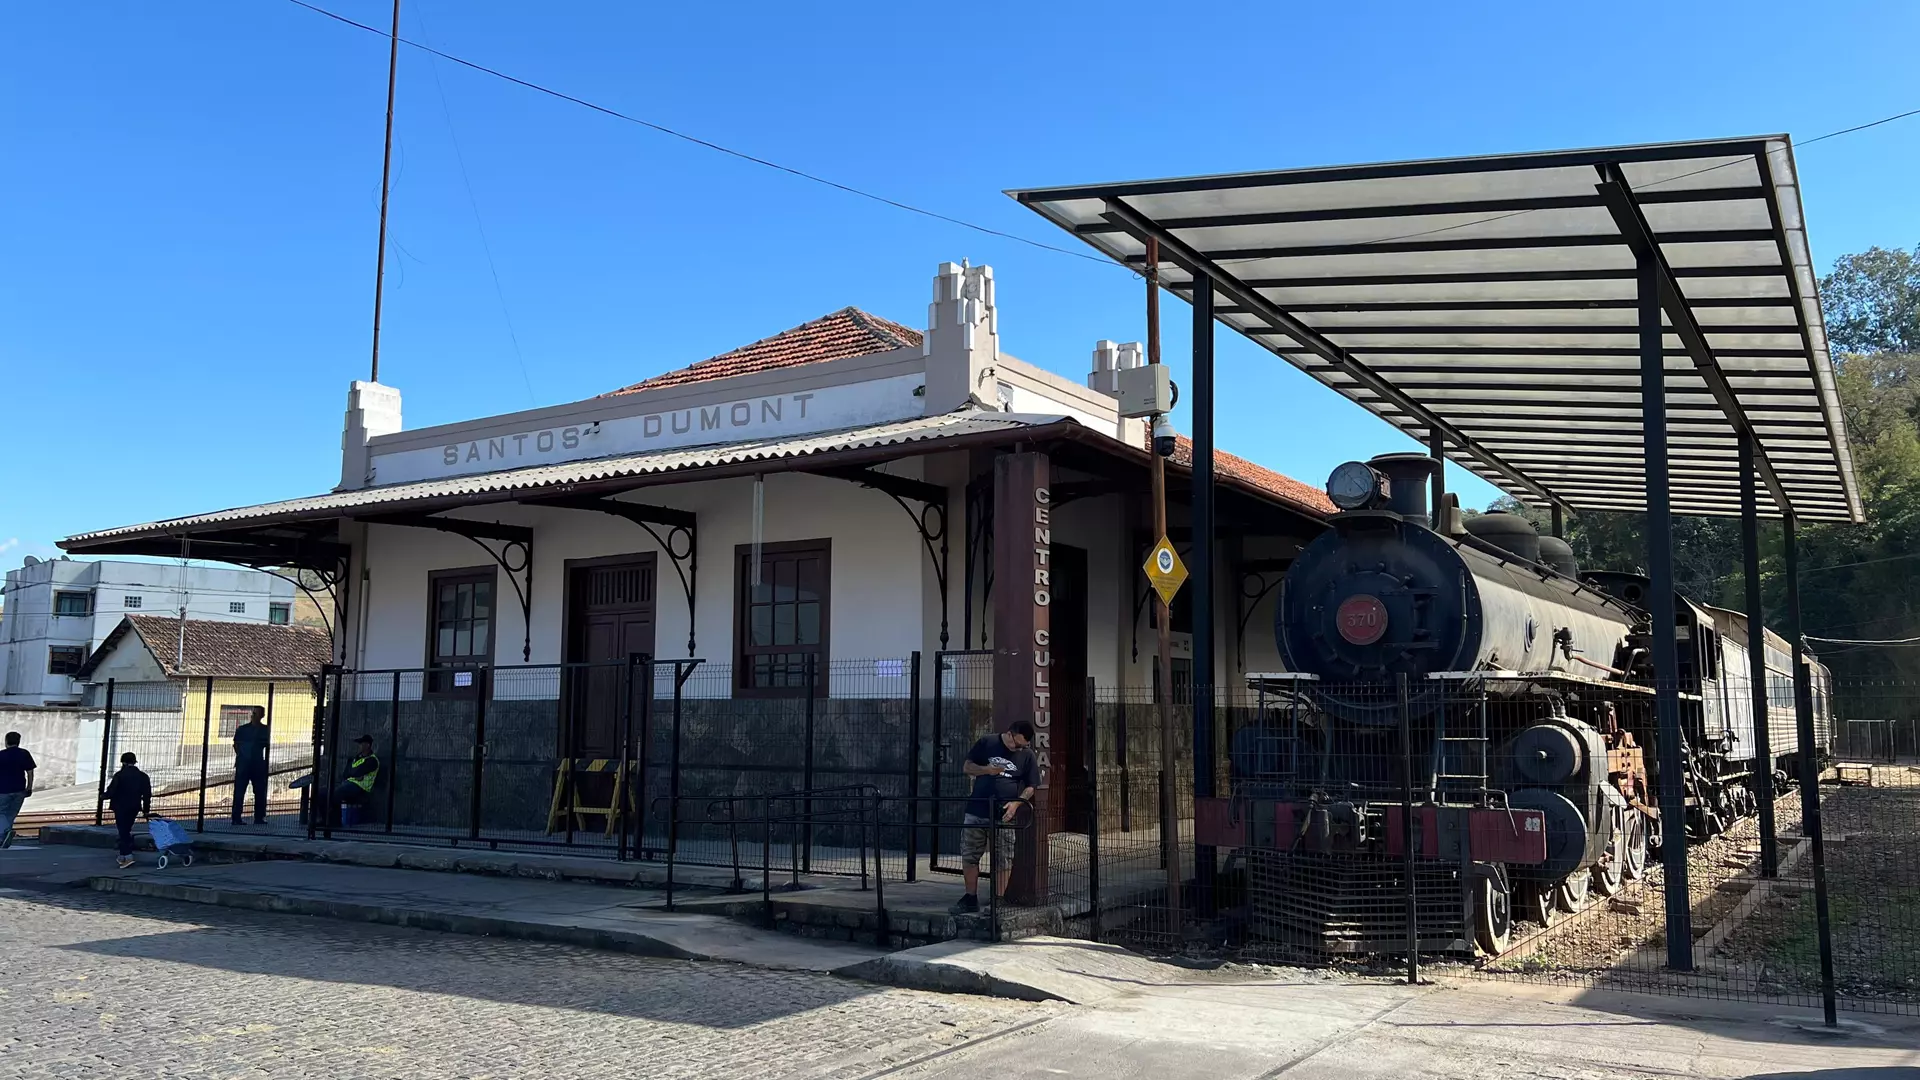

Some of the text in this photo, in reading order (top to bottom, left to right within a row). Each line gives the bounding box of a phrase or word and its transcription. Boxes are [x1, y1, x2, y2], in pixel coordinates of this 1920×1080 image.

[443, 393, 814, 466] SANTOS DUMONT
[1034, 486, 1050, 607] CENTRO
[1346, 612, 1376, 627] 370
